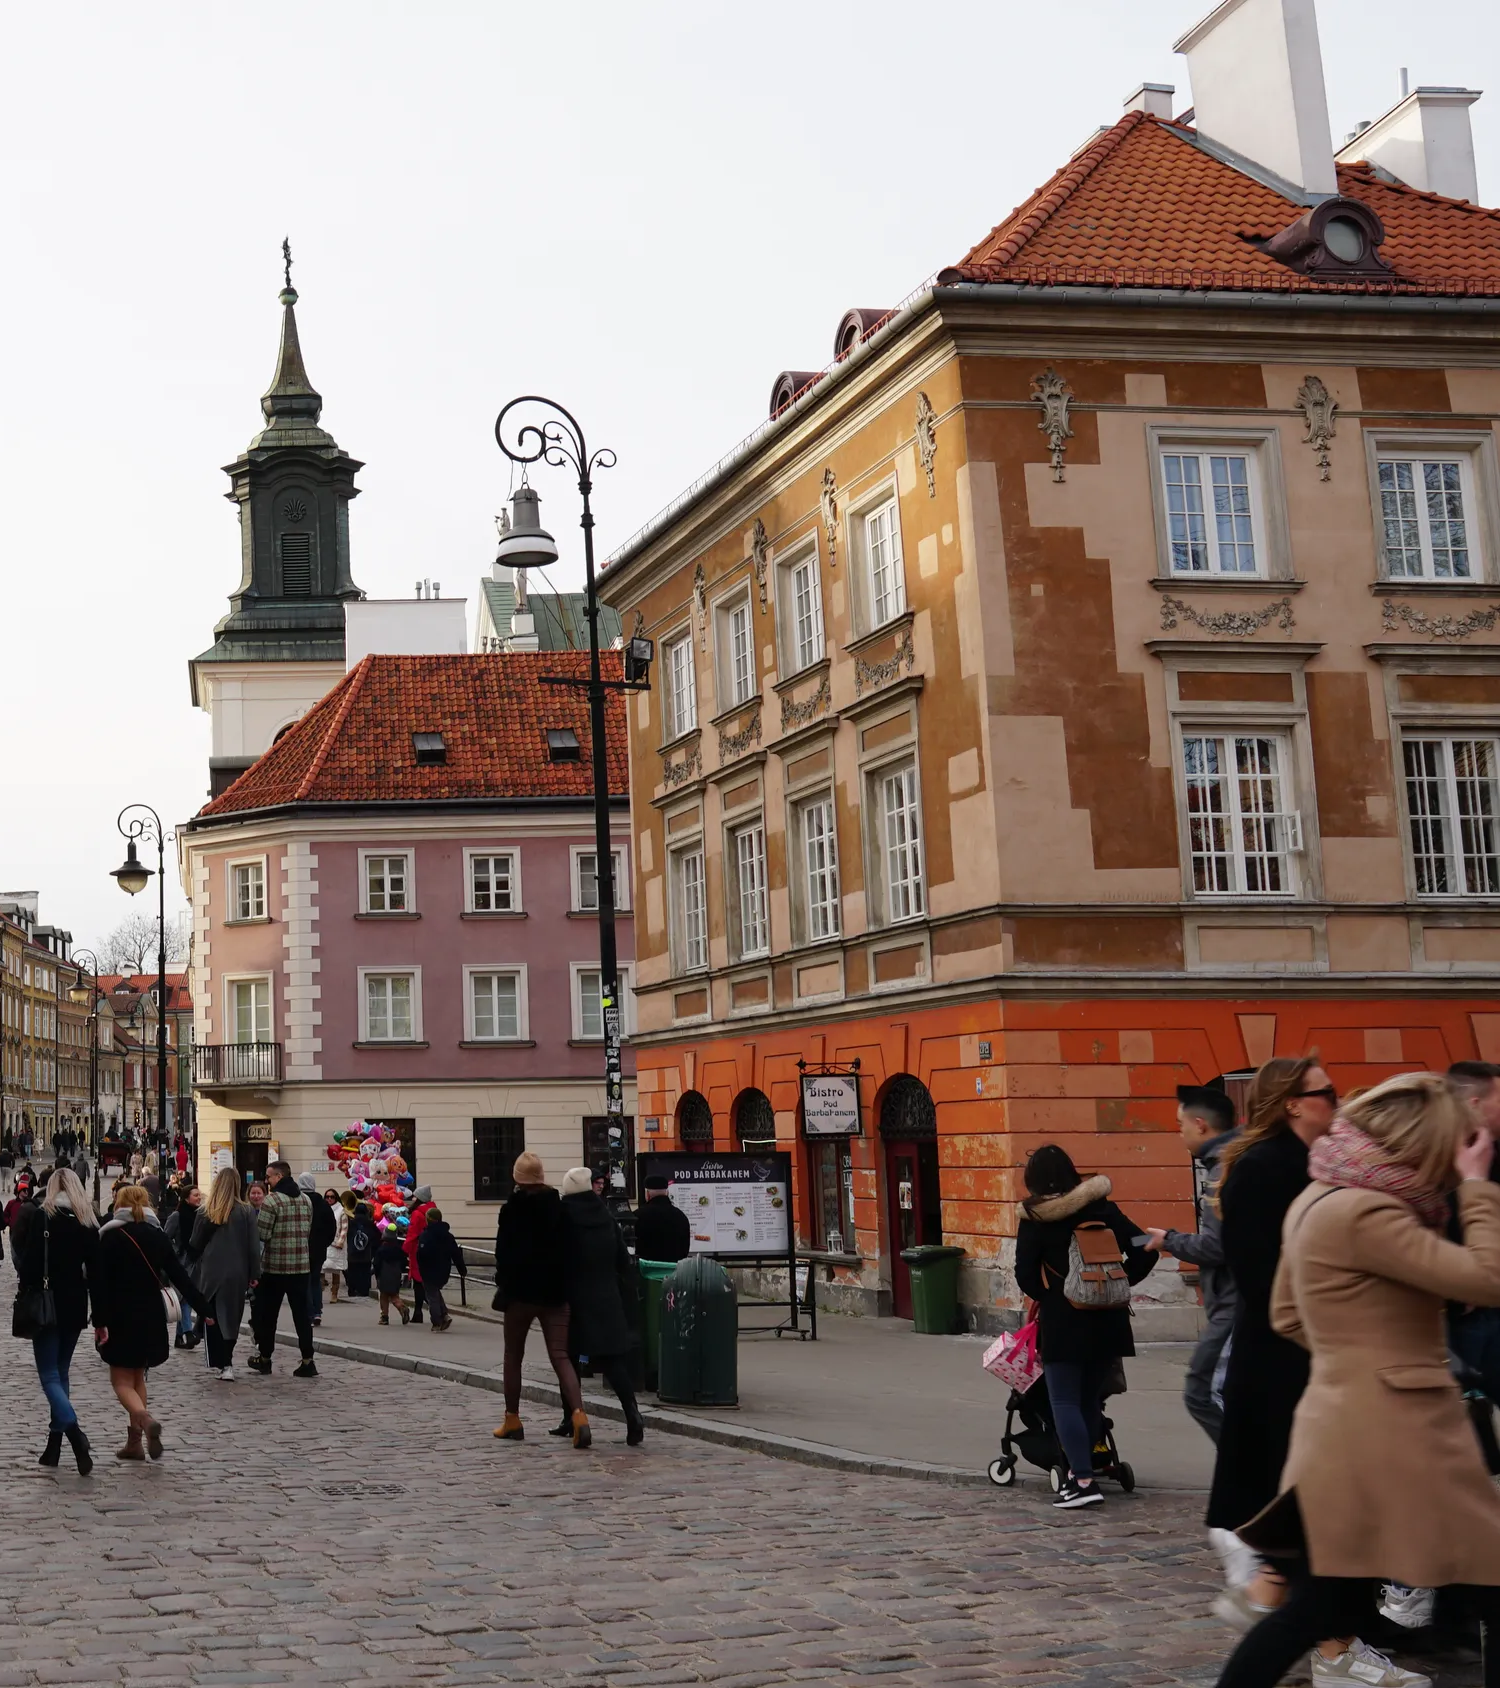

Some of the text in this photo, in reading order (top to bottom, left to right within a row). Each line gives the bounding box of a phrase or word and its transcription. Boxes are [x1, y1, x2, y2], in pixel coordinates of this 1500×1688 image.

[809, 1087, 844, 1097] Bistro
[823, 1100, 838, 1108] Pod
[700, 1160, 724, 1170] Bistro
[674, 1169, 750, 1179] POD BARBAKANEM
